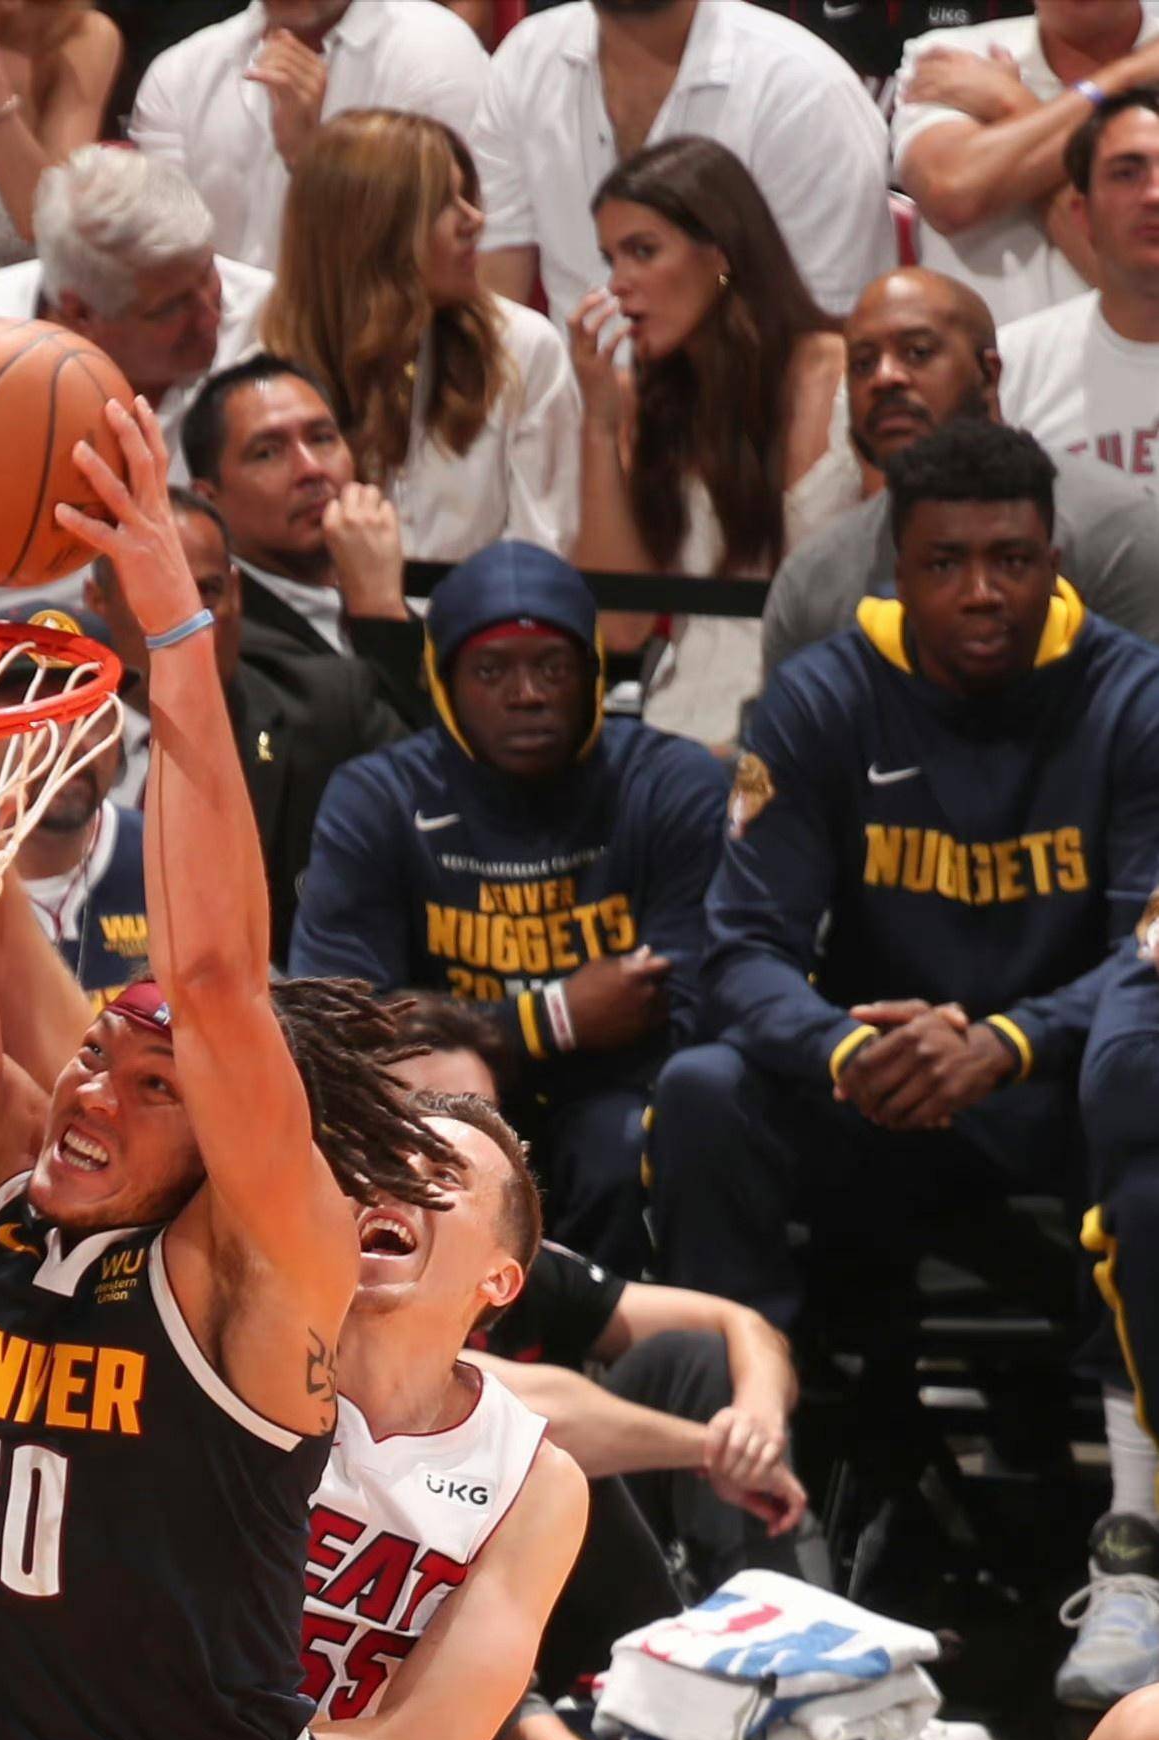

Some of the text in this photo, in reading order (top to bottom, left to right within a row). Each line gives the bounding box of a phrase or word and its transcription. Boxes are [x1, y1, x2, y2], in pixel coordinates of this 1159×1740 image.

[863, 823, 1089, 905] NUGGETS
[426, 893, 636, 975] NUGGETS
[102, 1248, 145, 1280] WU
[426, 1473, 490, 1507] UKG
[303, 1502, 470, 1632] EAT
